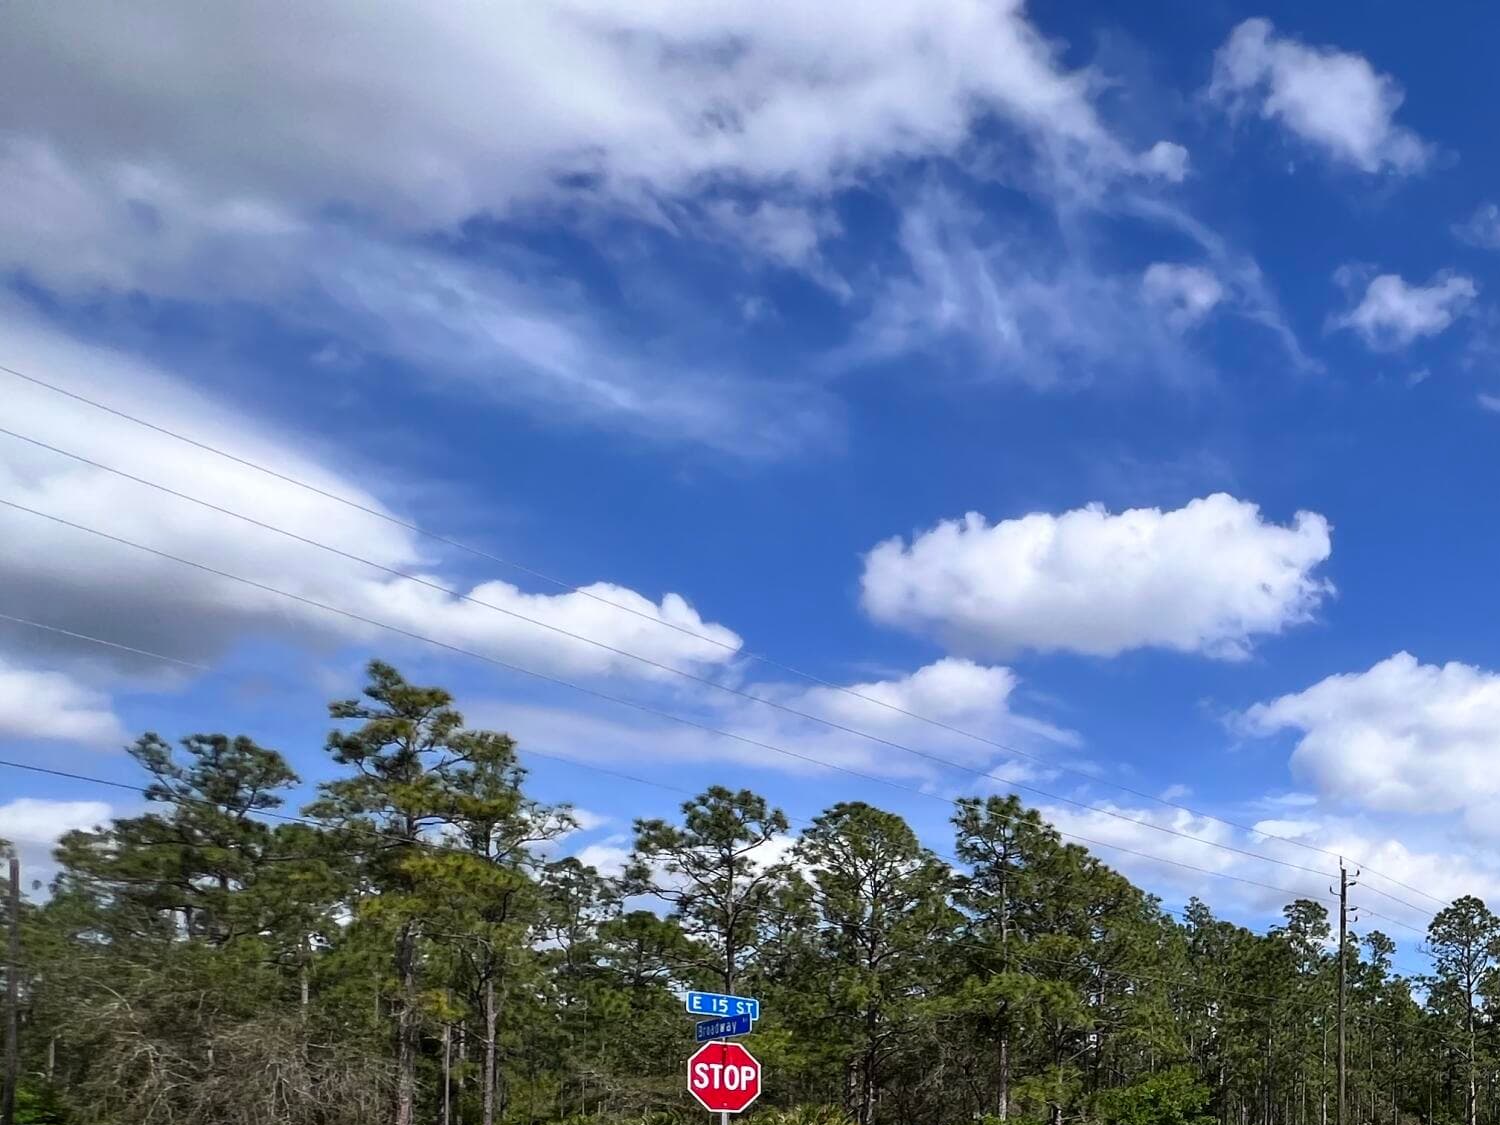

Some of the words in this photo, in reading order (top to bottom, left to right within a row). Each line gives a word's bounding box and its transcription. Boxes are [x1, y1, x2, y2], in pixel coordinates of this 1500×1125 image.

[693, 996, 702, 1010] E
[712, 998, 728, 1013] 15
[736, 1001, 753, 1014] ST
[697, 1021, 737, 1038] Broadway
[693, 1062, 756, 1091] STOP
